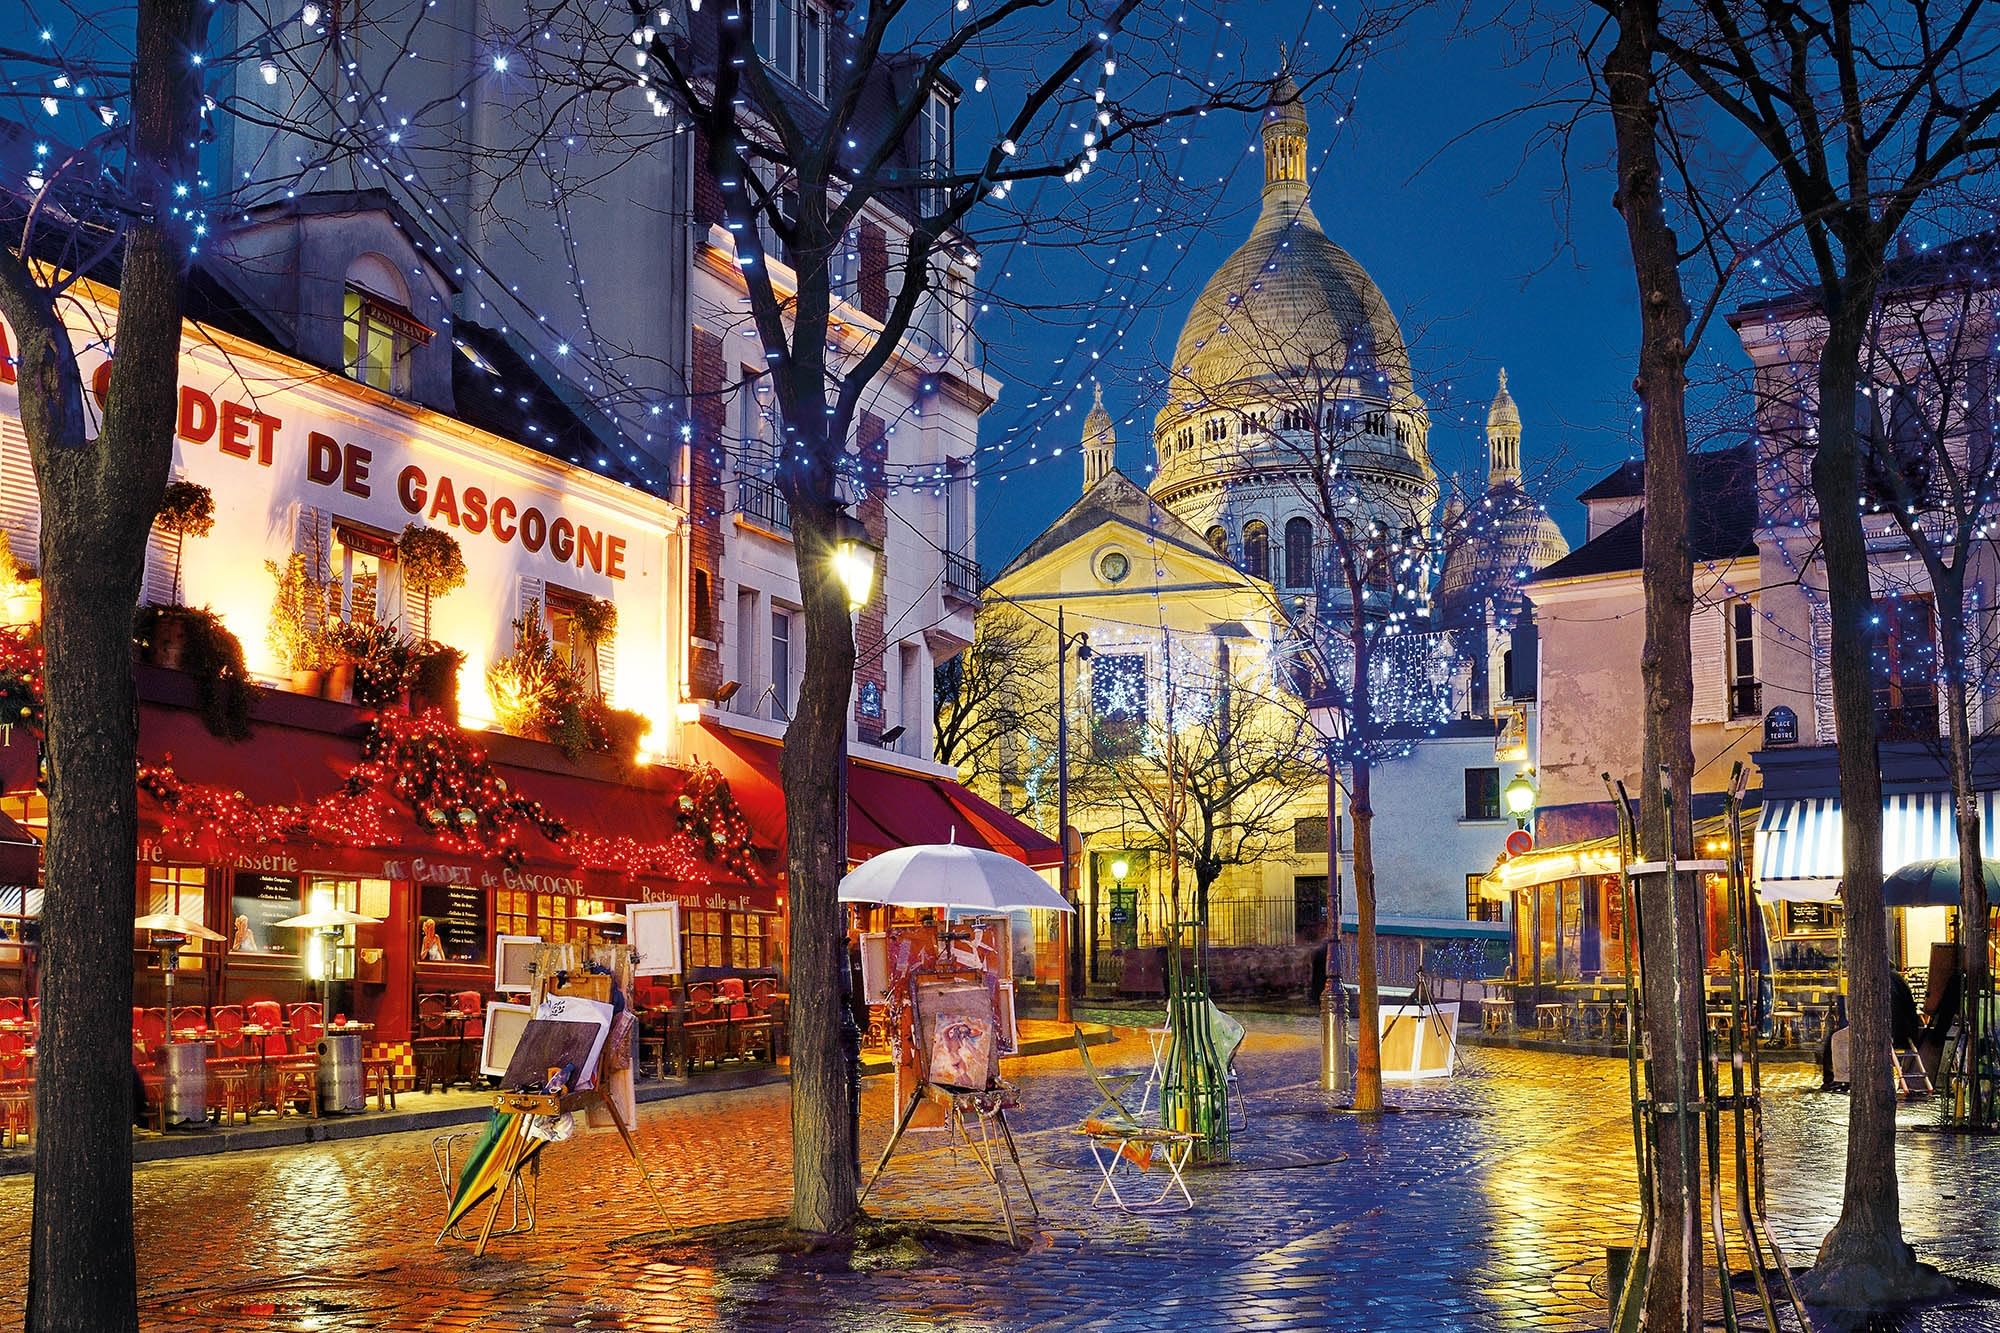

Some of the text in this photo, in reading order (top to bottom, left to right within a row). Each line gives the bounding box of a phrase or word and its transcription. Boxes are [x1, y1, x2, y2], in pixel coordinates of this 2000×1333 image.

[307, 431, 372, 499] DE
[397, 465, 626, 580] GASCOGNE
[208, 850, 299, 873] asserie
[481, 870, 499, 888] de
[503, 867, 585, 897] GASCOGNE
[642, 886, 701, 908] Restaurant
[705, 893, 726, 910] salle
